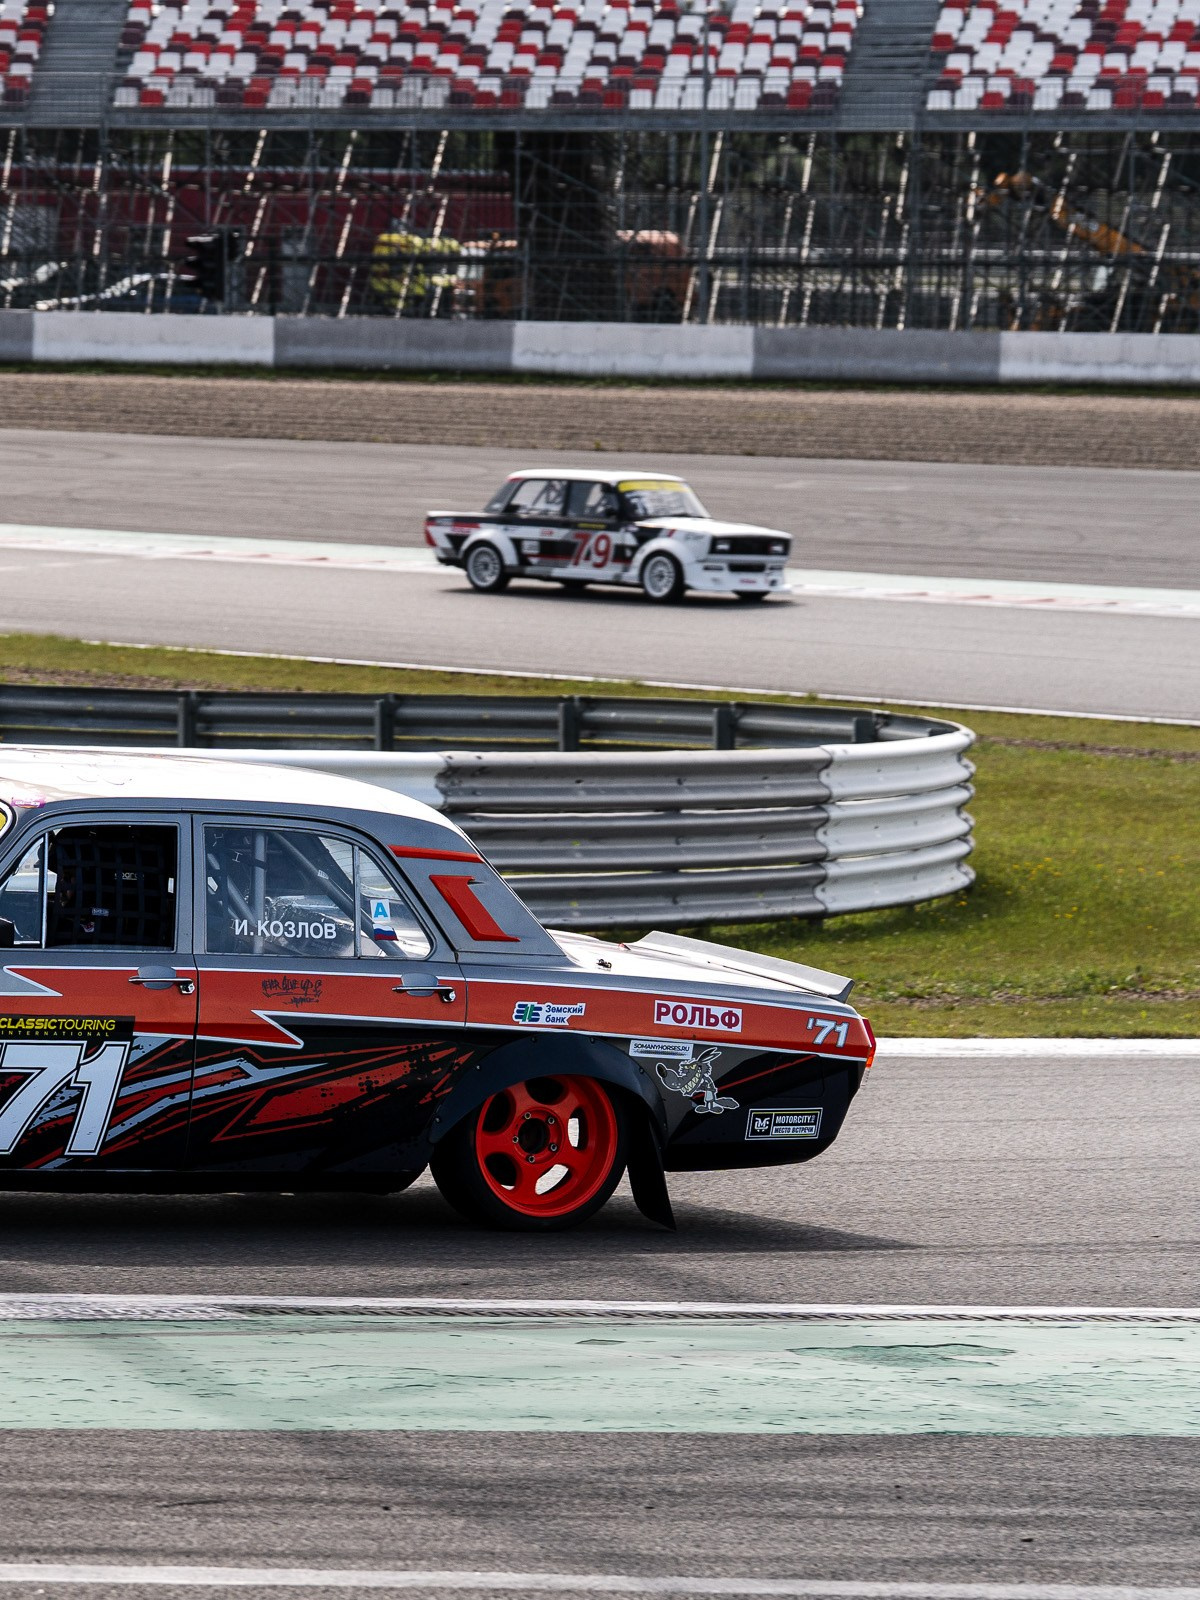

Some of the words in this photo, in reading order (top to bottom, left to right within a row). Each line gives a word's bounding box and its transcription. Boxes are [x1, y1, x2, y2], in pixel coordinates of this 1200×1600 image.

[571, 532, 612, 568] 79
[545, 1005, 584, 1014] Земский
[545, 1015, 567, 1023] банк
[656, 1003, 740, 1028] РОЛЬФ
[633, 1043, 690, 1052] SOMANYHORSES.RU
[775, 1115, 811, 1124] MOTORCITY
